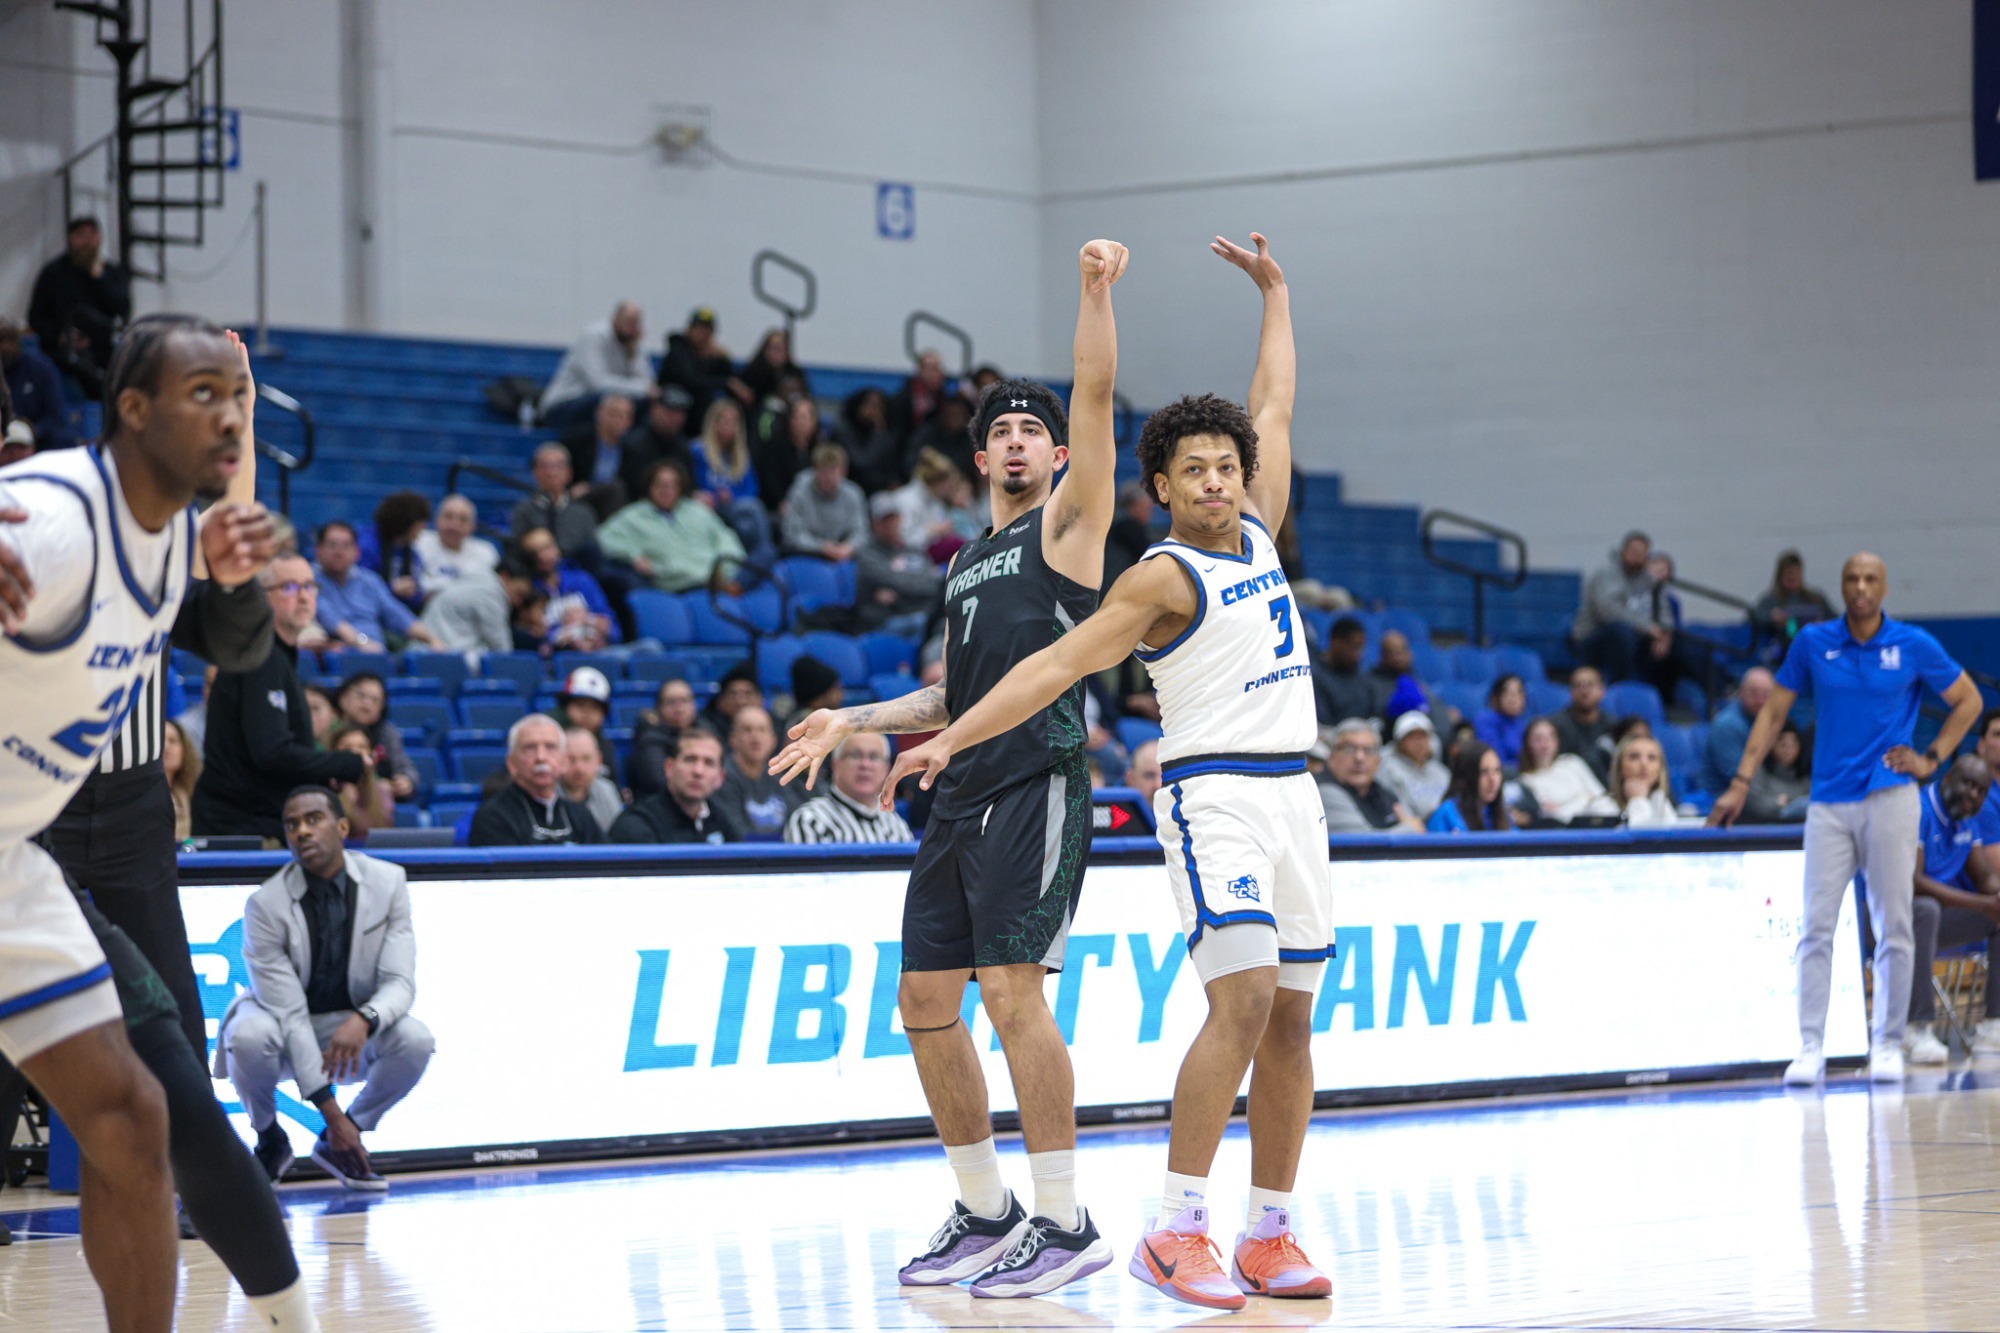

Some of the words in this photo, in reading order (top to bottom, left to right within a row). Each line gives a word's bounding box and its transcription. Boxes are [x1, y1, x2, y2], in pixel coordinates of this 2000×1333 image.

[884, 188, 907, 232] 6
[945, 546, 1023, 606] WAGNER
[962, 595, 979, 645] 7
[1268, 594, 1294, 660] 3
[1311, 920, 1538, 1033] ANK
